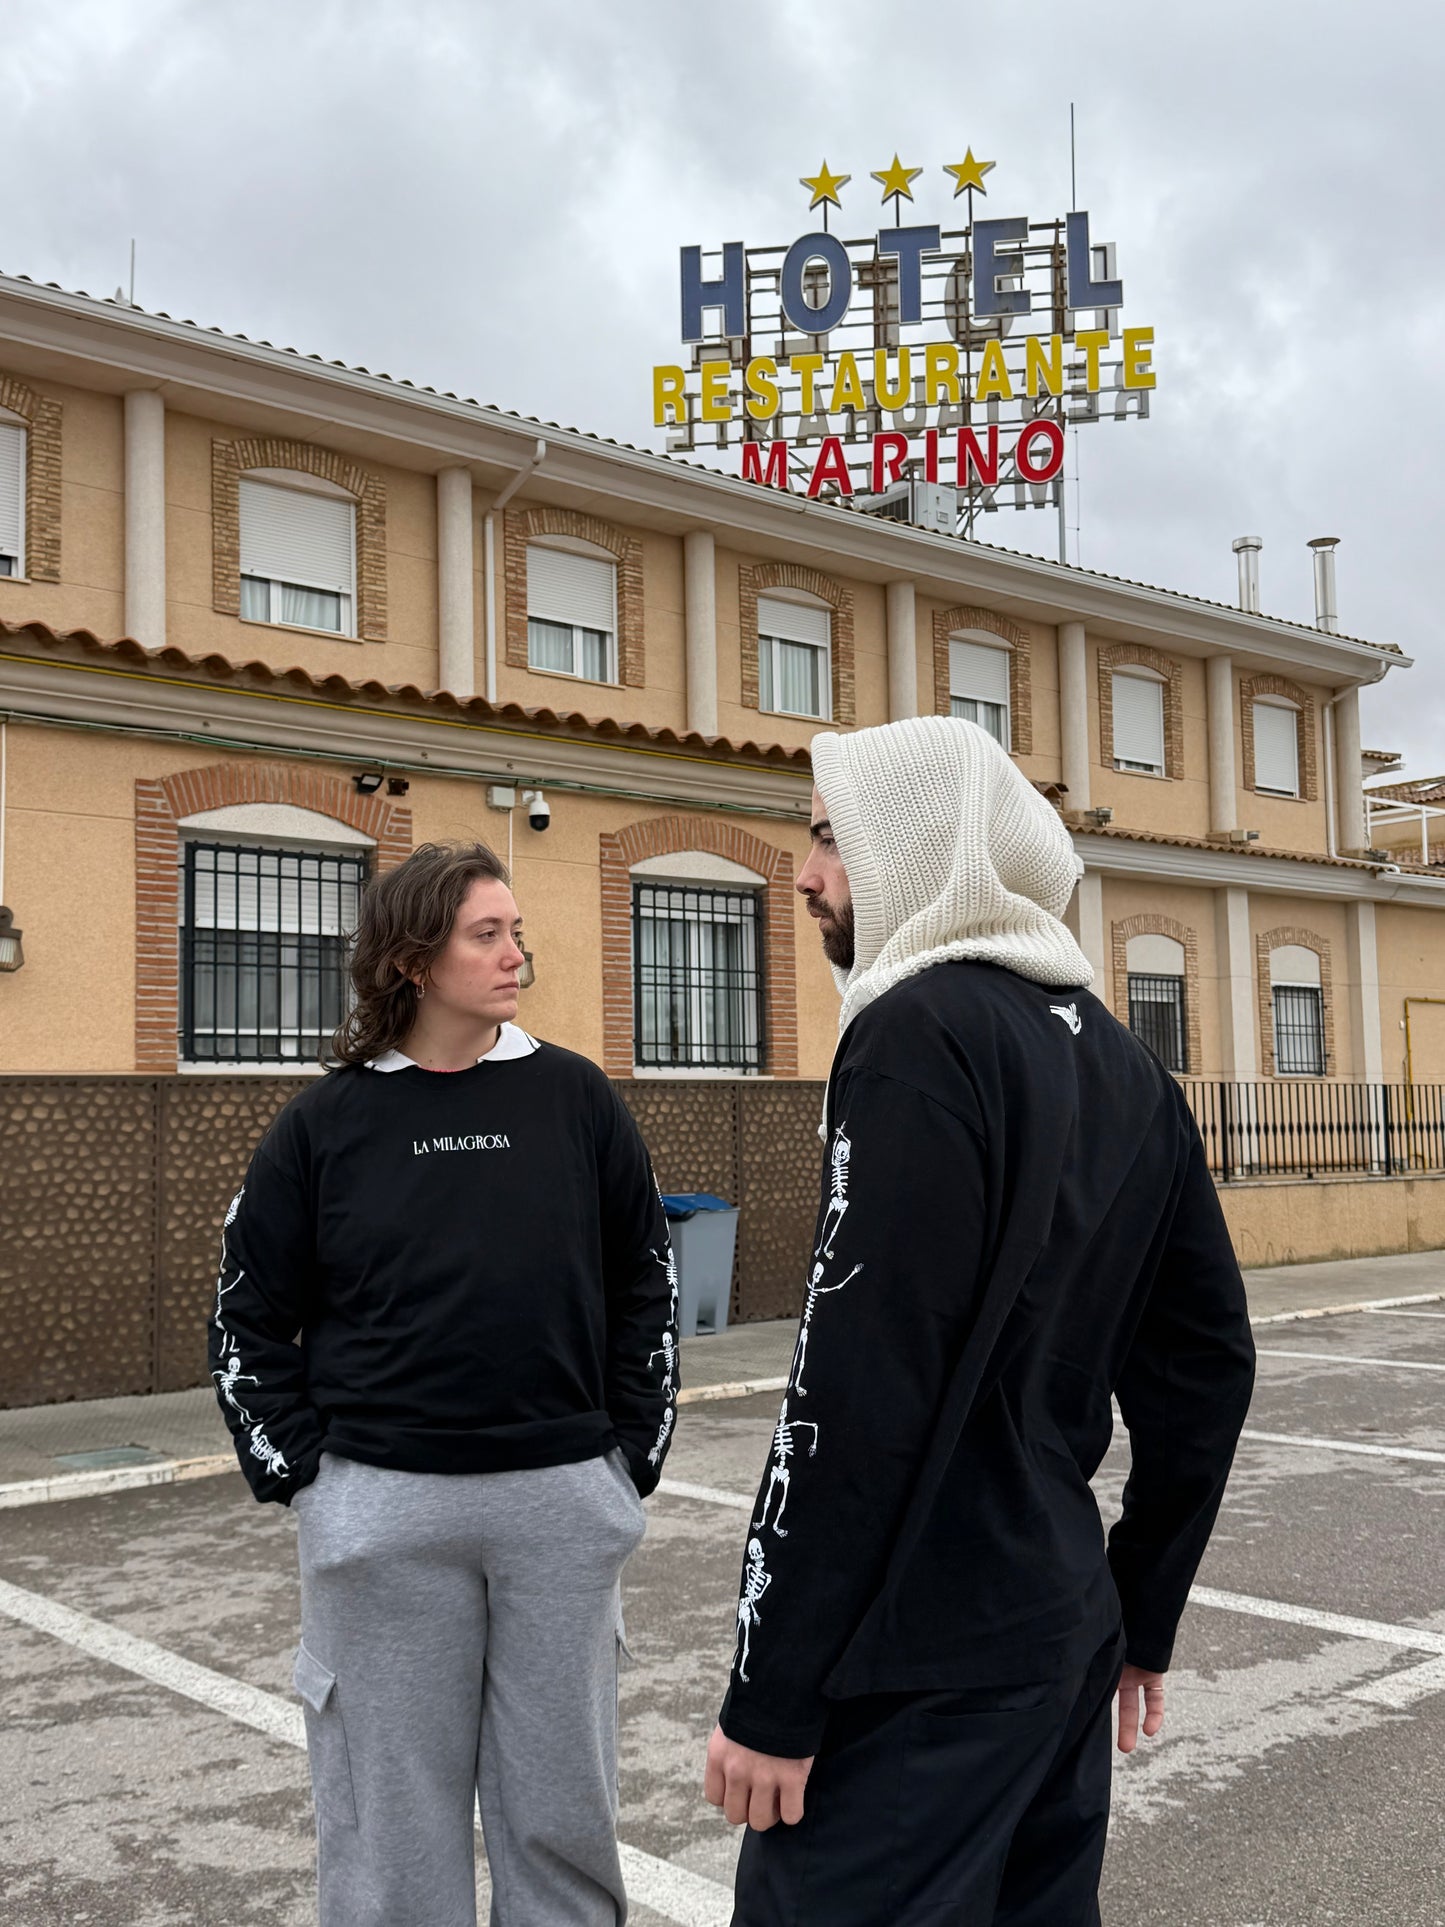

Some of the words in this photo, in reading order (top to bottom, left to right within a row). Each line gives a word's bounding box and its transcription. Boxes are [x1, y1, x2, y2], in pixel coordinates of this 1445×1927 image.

[680, 211, 1124, 343] HOTEL
[653, 326, 1157, 427] RESTAURANTE
[742, 419, 1065, 498] MARINO
[413, 1140, 430, 1156] LA
[432, 1134, 511, 1152] MILAGROSA
